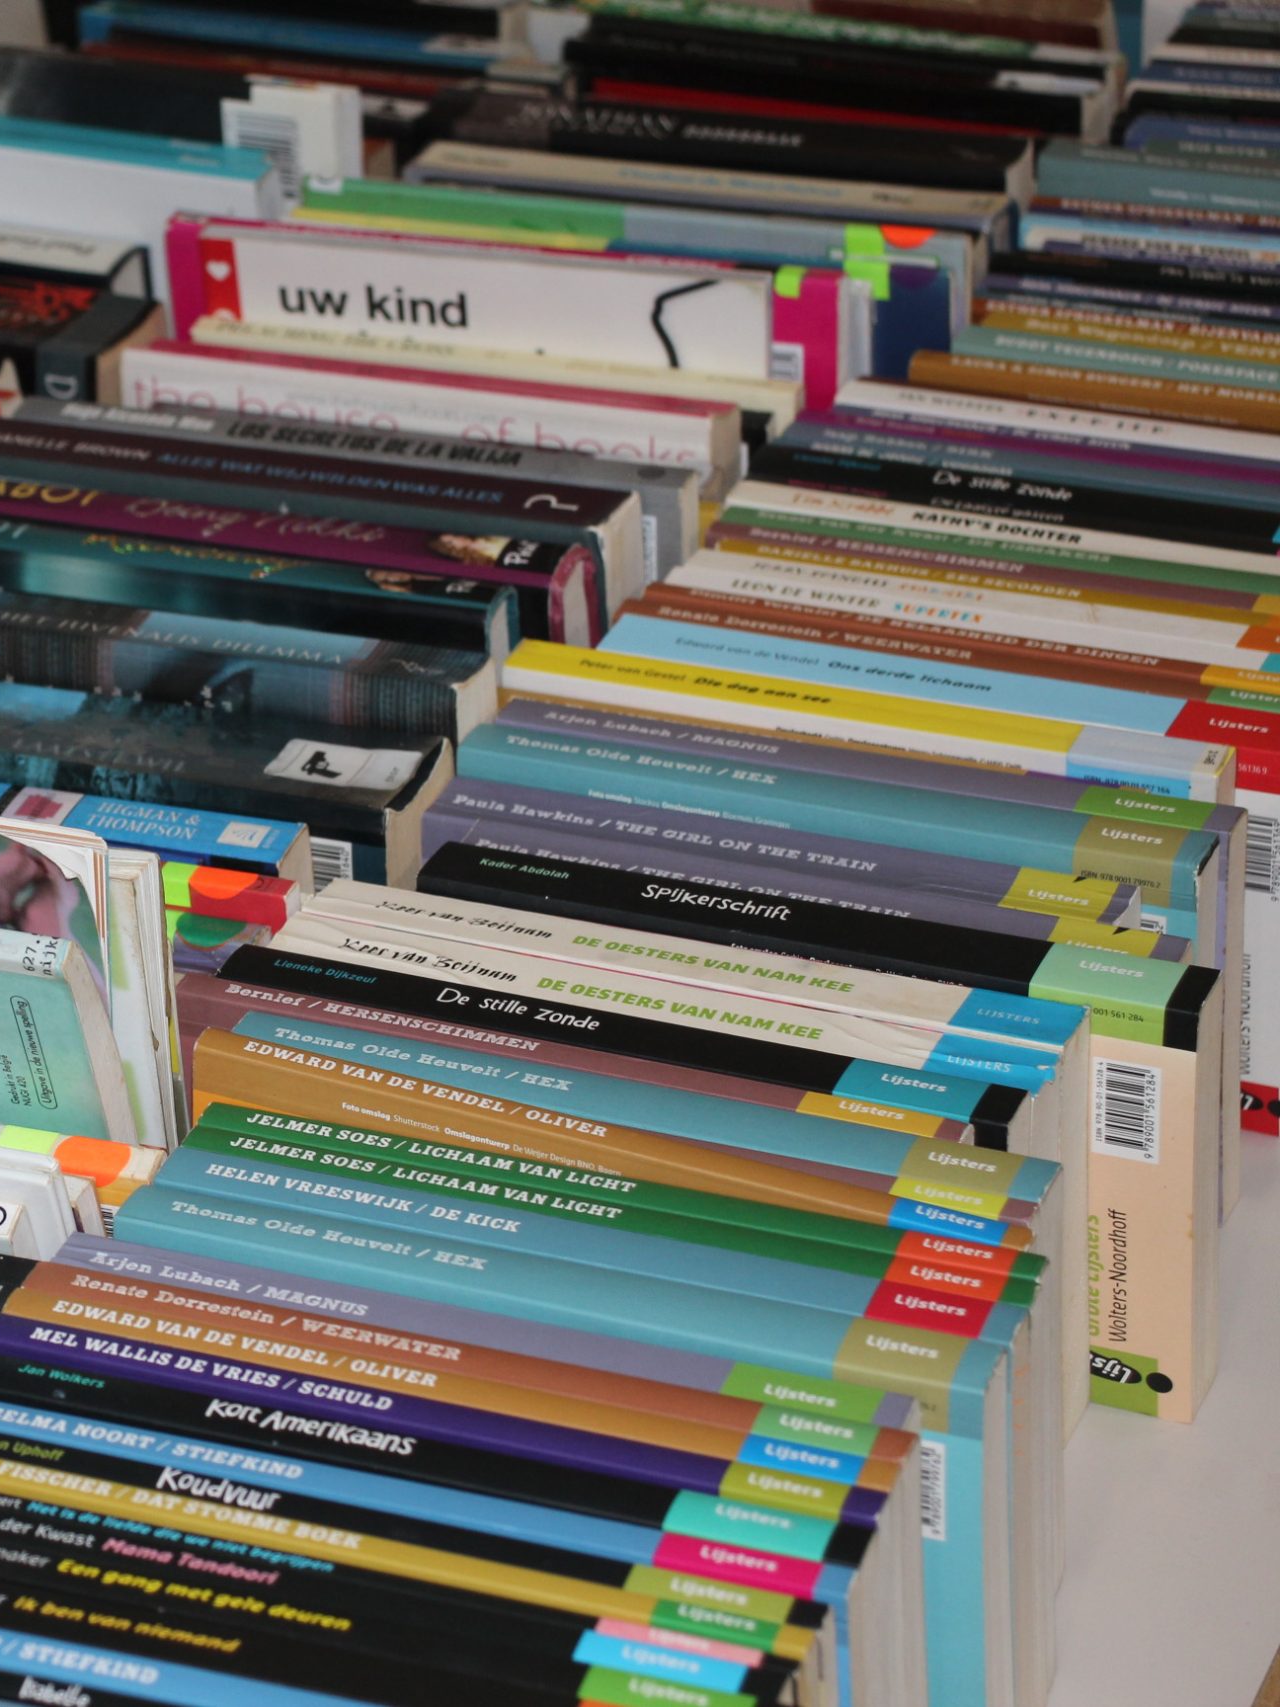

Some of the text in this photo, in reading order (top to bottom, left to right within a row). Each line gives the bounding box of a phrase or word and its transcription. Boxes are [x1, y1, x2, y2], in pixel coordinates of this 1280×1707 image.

[279, 285, 468, 328] uw kind
[932, 469, 1072, 502] De stille zonde
[912, 511, 1082, 545] KATHY'S DOCHTER
[85, 812, 199, 842] THOMPSON
[453, 792, 877, 873] Paula Hawkins THE GIRL ON THE TRAIN
[1100, 828, 1164, 845] Lijsters
[479, 856, 792, 924] Kader Abdolah Spijkerschrift
[571, 934, 855, 993] DE OESTERS VAN NAM KEE
[225, 983, 539, 1053] Bernlef HERSENSCHIMMEN
[436, 987, 600, 1032] De stille zonde
[537, 976, 823, 1040] DE OESTERS VAN NAM KEE
[243, 1040, 608, 1138] EDWARD VAN DE VENDEL OLIVER
[246, 1112, 637, 1195] JELMER SOES LICHAAM VAN LICHT
[927, 1151, 997, 1175] Lijsters
[206, 1164, 522, 1234] HELEN VREESWIJK DE KICK
[922, 1236, 994, 1261] Lijsters
[1107, 1208, 1127, 1343] Wolters-Noordhoff
[30, 1327, 394, 1411] MEL WALLIS DE VRIES SCHULD
[865, 1334, 940, 1360] Lijsters
[763, 1383, 837, 1409] Lijsters
[71, 1424, 155, 1453] NOORT
[171, 1442, 304, 1480] STIEFKIND
[205, 1398, 418, 1457] Kort Amerikaans
[764, 1444, 840, 1470] Lijsters
[700, 1545, 778, 1574] Lijsters
